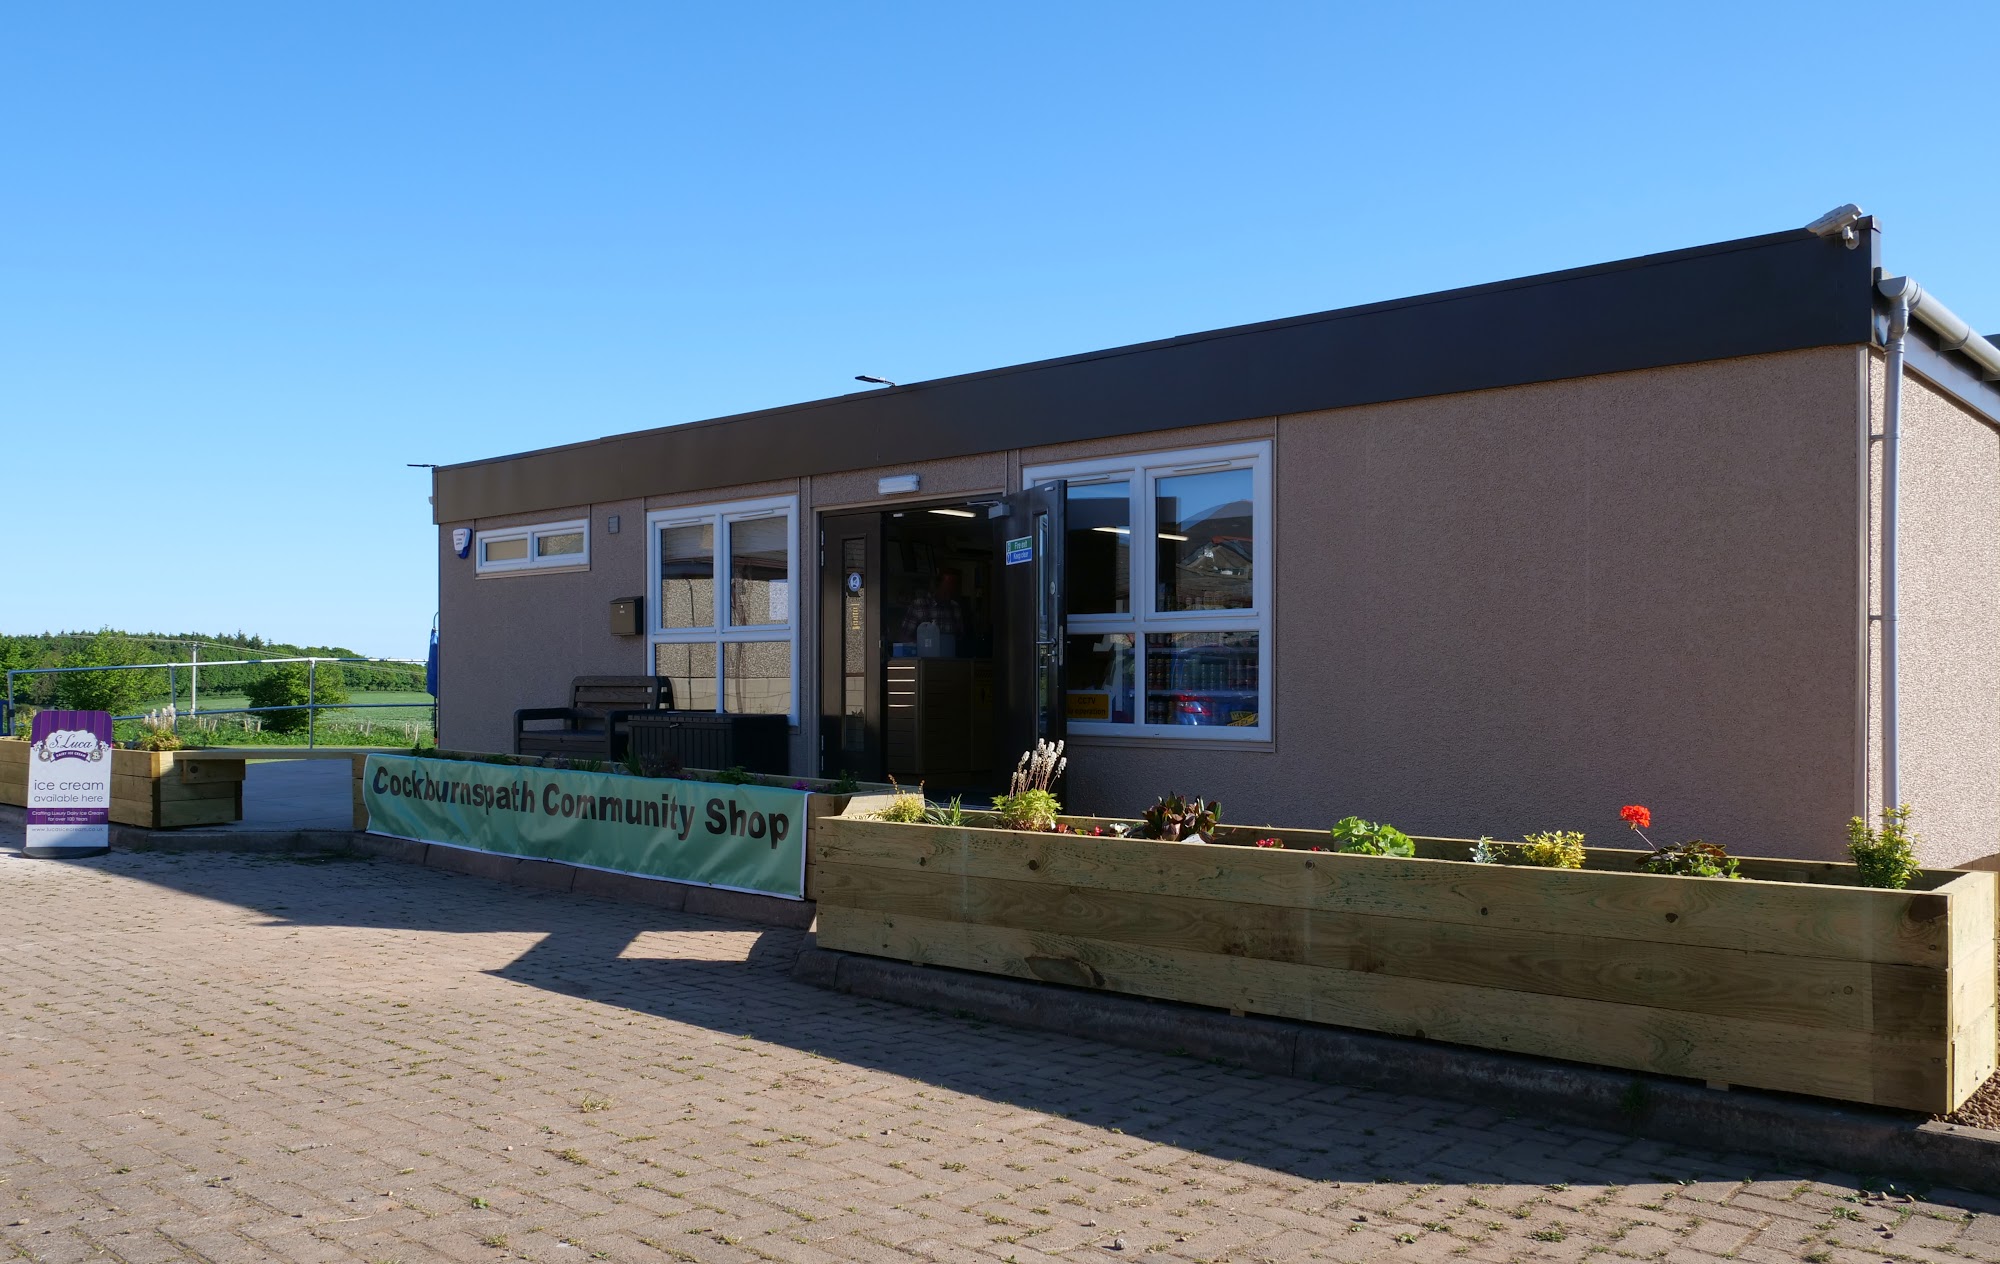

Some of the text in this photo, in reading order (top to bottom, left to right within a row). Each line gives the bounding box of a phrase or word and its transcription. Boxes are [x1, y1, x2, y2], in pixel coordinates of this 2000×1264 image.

[1077, 696, 1096, 705] CCTV
[34, 779, 104, 791] ice cream
[34, 794, 104, 803] available here
[372, 766, 789, 849] Cockburnspath Community Shop
